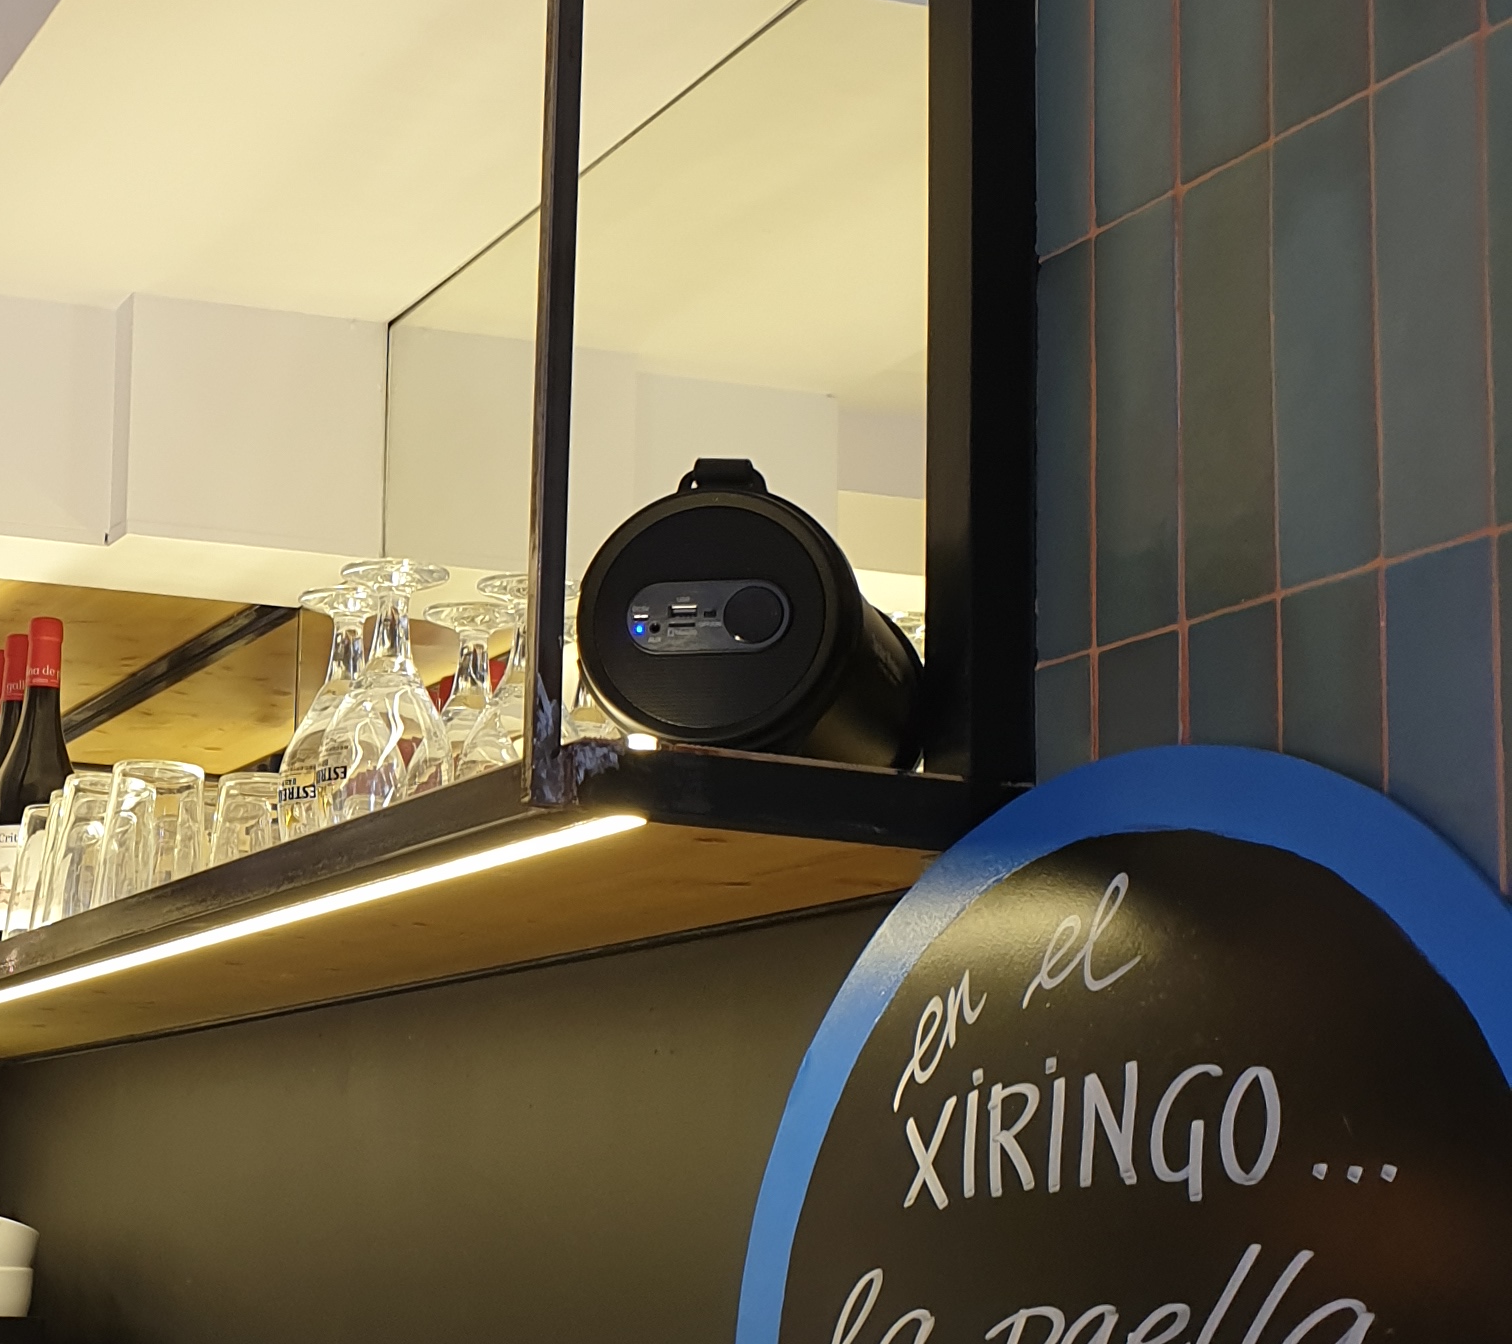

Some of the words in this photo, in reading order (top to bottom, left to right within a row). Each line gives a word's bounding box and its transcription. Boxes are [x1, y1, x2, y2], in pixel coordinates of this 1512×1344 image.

[6, 680, 25, 693] gall
[893, 970, 987, 1113] en
[1023, 872, 1142, 1009] el
